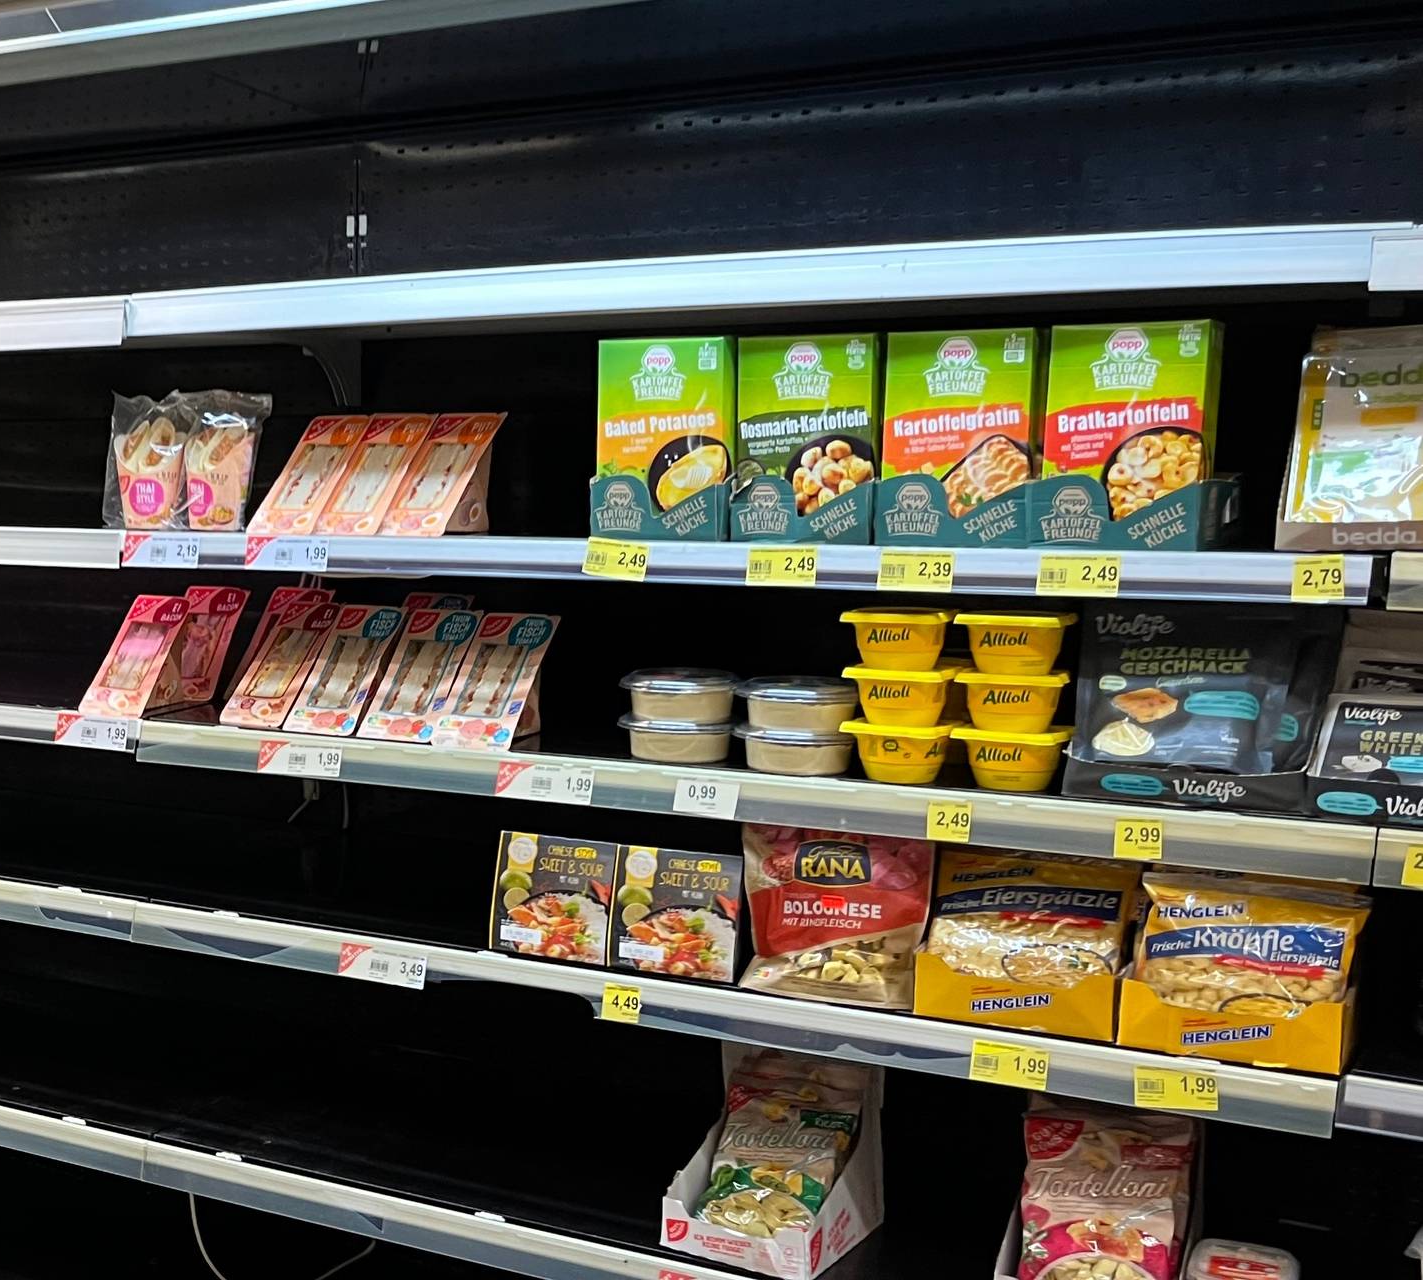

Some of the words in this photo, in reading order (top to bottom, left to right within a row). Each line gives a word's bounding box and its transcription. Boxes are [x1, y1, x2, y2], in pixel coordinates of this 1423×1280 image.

[1112, 339, 1142, 350] popp
[647, 356, 670, 366] popp
[790, 354, 817, 364] popp
[944, 348, 971, 359] popp
[925, 370, 985, 383] KARTOFFEL
[1092, 362, 1157, 377] KARTOFFEL
[774, 374, 829, 387] KARTOFFEL
[929, 380, 984, 395] FREUNDE
[1096, 373, 1154, 388] FREUNDE
[777, 385, 829, 398] FREUNDE
[604, 416, 646, 438] Baked
[649, 412, 715, 433] Potatoes
[740, 409, 868, 439] Rosmarin-Kartoffeln
[894, 407, 1020, 437] Kartoffelgratin
[1058, 402, 1189, 433] Bratkartoffeln
[136, 482, 155, 494] THAI
[136, 495, 155, 504] STYLE
[901, 493, 926, 503] popp
[1059, 498, 1086, 508] popp
[596, 509, 642, 521] KARTOFFEL
[662, 496, 707, 529] SCHNELLE
[738, 511, 789, 522] KARTOFFEL
[810, 498, 857, 532] SCHNELLE
[885, 512, 940, 524] KARTOFFEL
[963, 500, 1017, 534] SCHNELLE
[598, 517, 642, 530] FREUNDE
[675, 511, 709, 537] KÜCHE
[740, 519, 789, 533] FREUNDE
[824, 514, 858, 539] KÜCHE
[888, 521, 938, 534] FREUNDE
[1040, 517, 1102, 530] KARTOFFEL
[1127, 502, 1187, 540] SCHNELLE
[978, 516, 1018, 543] KÜCHE
[1043, 528, 1100, 540] FREUNDE
[1144, 520, 1187, 548] KÜCHE
[1332, 527, 1417, 546] bedda
[176, 544, 198, 559] 2,19
[305, 547, 327, 561] 1,99
[617, 551, 646, 568] 2,49
[784, 557, 815, 574] 2,49
[918, 561, 952, 579] 2,39
[1081, 565, 1118, 584] 2,49
[1302, 568, 1342, 589] 2,79
[217, 602, 239, 612] BACON
[161, 613, 183, 622] BACON
[370, 619, 395, 630] FISCH
[443, 621, 472, 633] FISCH
[516, 625, 547, 638] FISCH
[1095, 613, 1176, 642] Violife
[867, 627, 910, 644] Allioli
[979, 631, 1028, 648] Allioli
[1120, 647, 1250, 660] MOZZARELLA
[1120, 659, 1249, 675] GESCHMACK
[868, 684, 910, 700] Allioli
[983, 690, 1031, 705] Allioli
[1344, 707, 1403, 726] Violife
[107, 727, 126, 740] 1,99
[976, 745, 1022, 762] Allioli
[1359, 741, 1423, 756] WHITE
[319, 752, 340, 766] 1,99
[566, 777, 592, 792] 1,99
[688, 784, 716, 800] 0,99
[1172, 778, 1247, 803] Violife
[936, 811, 970, 830] 2,49
[1124, 826, 1161, 845] 2,99
[548, 845, 574, 857] CHINESE
[539, 857, 567, 873] SWEET
[578, 862, 605, 877] SOUR
[669, 858, 696, 871] CHINESE
[801, 857, 866, 879] RANA
[659, 872, 689, 887] SWEET
[702, 876, 730, 892] SOUR
[952, 867, 1035, 883] HENGLEIN
[981, 888, 1118, 911] Eierspätzle
[1157, 903, 1245, 918] HENGLEIN
[782, 917, 799, 926] MIT
[1194, 929, 1294, 957] Knöpfle
[400, 961, 424, 977] 3,49
[612, 994, 639, 1011] 4,49
[971, 994, 1051, 1013] HENGLEIN
[1182, 1025, 1271, 1045] HENGLEIN
[1013, 1056, 1047, 1075] 1,99
[1180, 1076, 1217, 1095] 1,99
[717, 1121, 835, 1152] Tortelloni
[1027, 1164, 1169, 1200] Tortelloni
